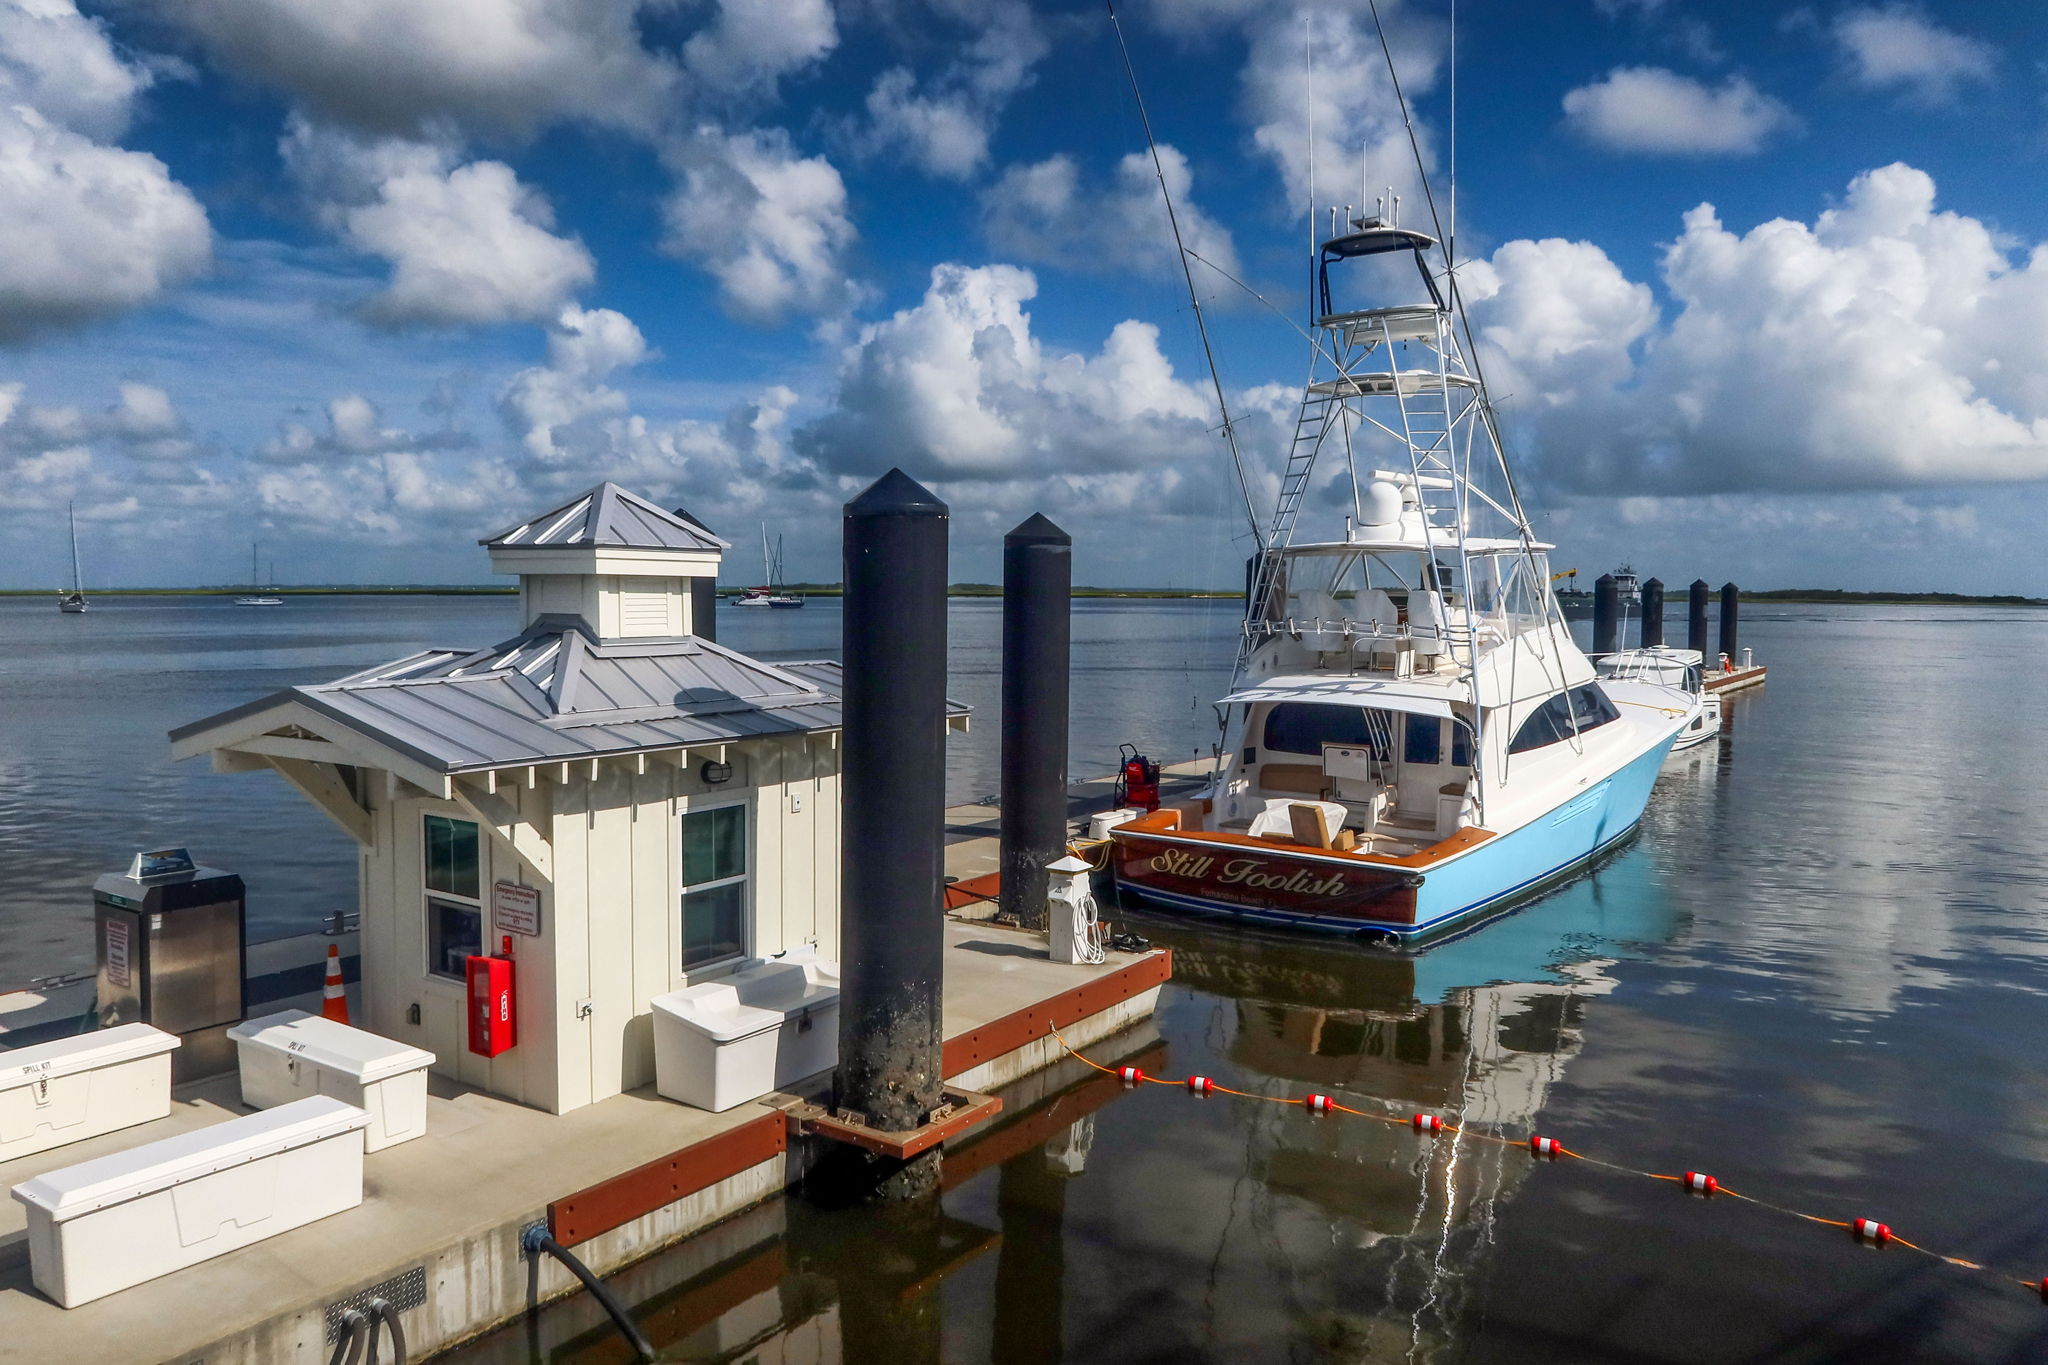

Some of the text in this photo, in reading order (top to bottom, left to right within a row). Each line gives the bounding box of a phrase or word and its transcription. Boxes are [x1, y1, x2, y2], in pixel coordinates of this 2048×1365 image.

[1150, 848, 1349, 897] Still Foolish
[22, 1061, 51, 1074] SPILL KIT
